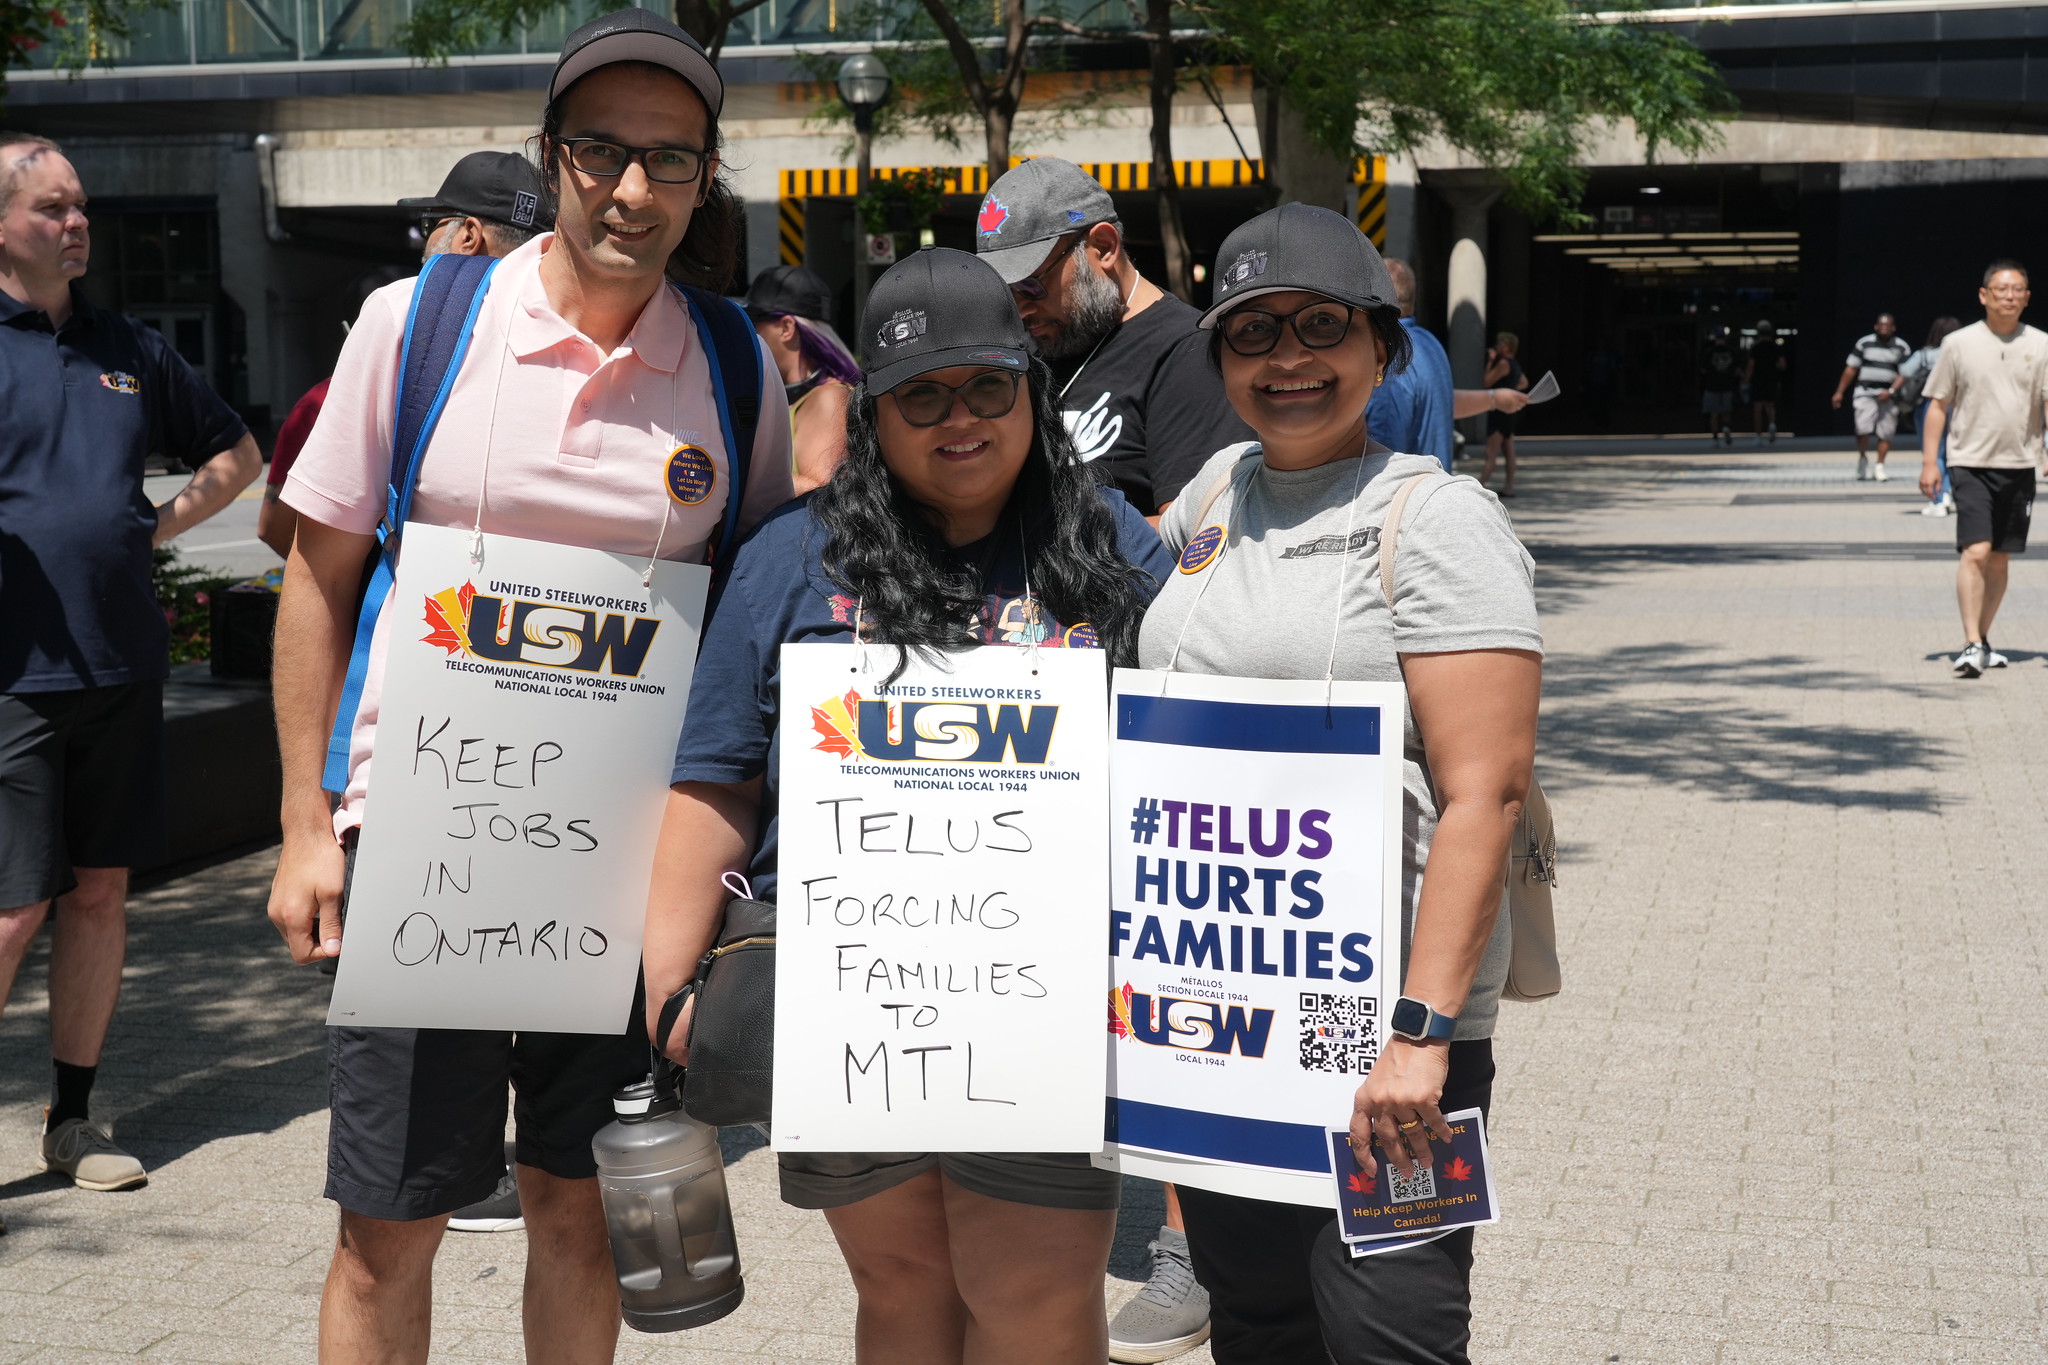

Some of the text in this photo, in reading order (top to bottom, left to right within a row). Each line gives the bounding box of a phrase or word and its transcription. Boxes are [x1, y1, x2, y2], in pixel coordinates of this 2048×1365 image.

[673, 460, 691, 468] Where
[682, 452, 691, 460] We
[678, 485, 694, 493] Where
[490, 580, 647, 613] UNITED STEELWORKERS
[466, 593, 662, 677] USW
[445, 660, 665, 696] TELECOMMUNICATIONS WORKERS UNION
[494, 679, 618, 703] NATIONAL LOCAL 1944
[873, 685, 1042, 700] UNITED STEELWORKERS
[856, 700, 1061, 765] USW
[414, 715, 563, 790] KEEP
[840, 765, 1080, 781] TELECOMMUNICATIONS WORKERS UNION
[894, 779, 1028, 792] NATIONAL LOCAL 1944
[447, 803, 599, 852] JOBS
[816, 797, 1033, 855] TELUS
[1130, 796, 1333, 860] #TELUS
[422, 855, 472, 898] IN
[1135, 855, 1325, 920] HURTS
[801, 876, 1020, 929] FORCING
[392, 911, 608, 966] ONTARIO
[1109, 909, 1374, 983] FAMILIES
[835, 944, 1048, 998] FAMILIES
[1180, 976, 1223, 989] MÉTALLOS
[1157, 984, 1249, 1002] SECTION LOCALE 1944
[880, 1004, 938, 1029] TO
[1131, 991, 1276, 1059] USW
[845, 1041, 1016, 1112] MTL
[1175, 1054, 1226, 1067] LOCAL 1944
[1353, 1193, 1478, 1217] Help Keep Workers In
[1393, 1214, 1441, 1228] Canada!
